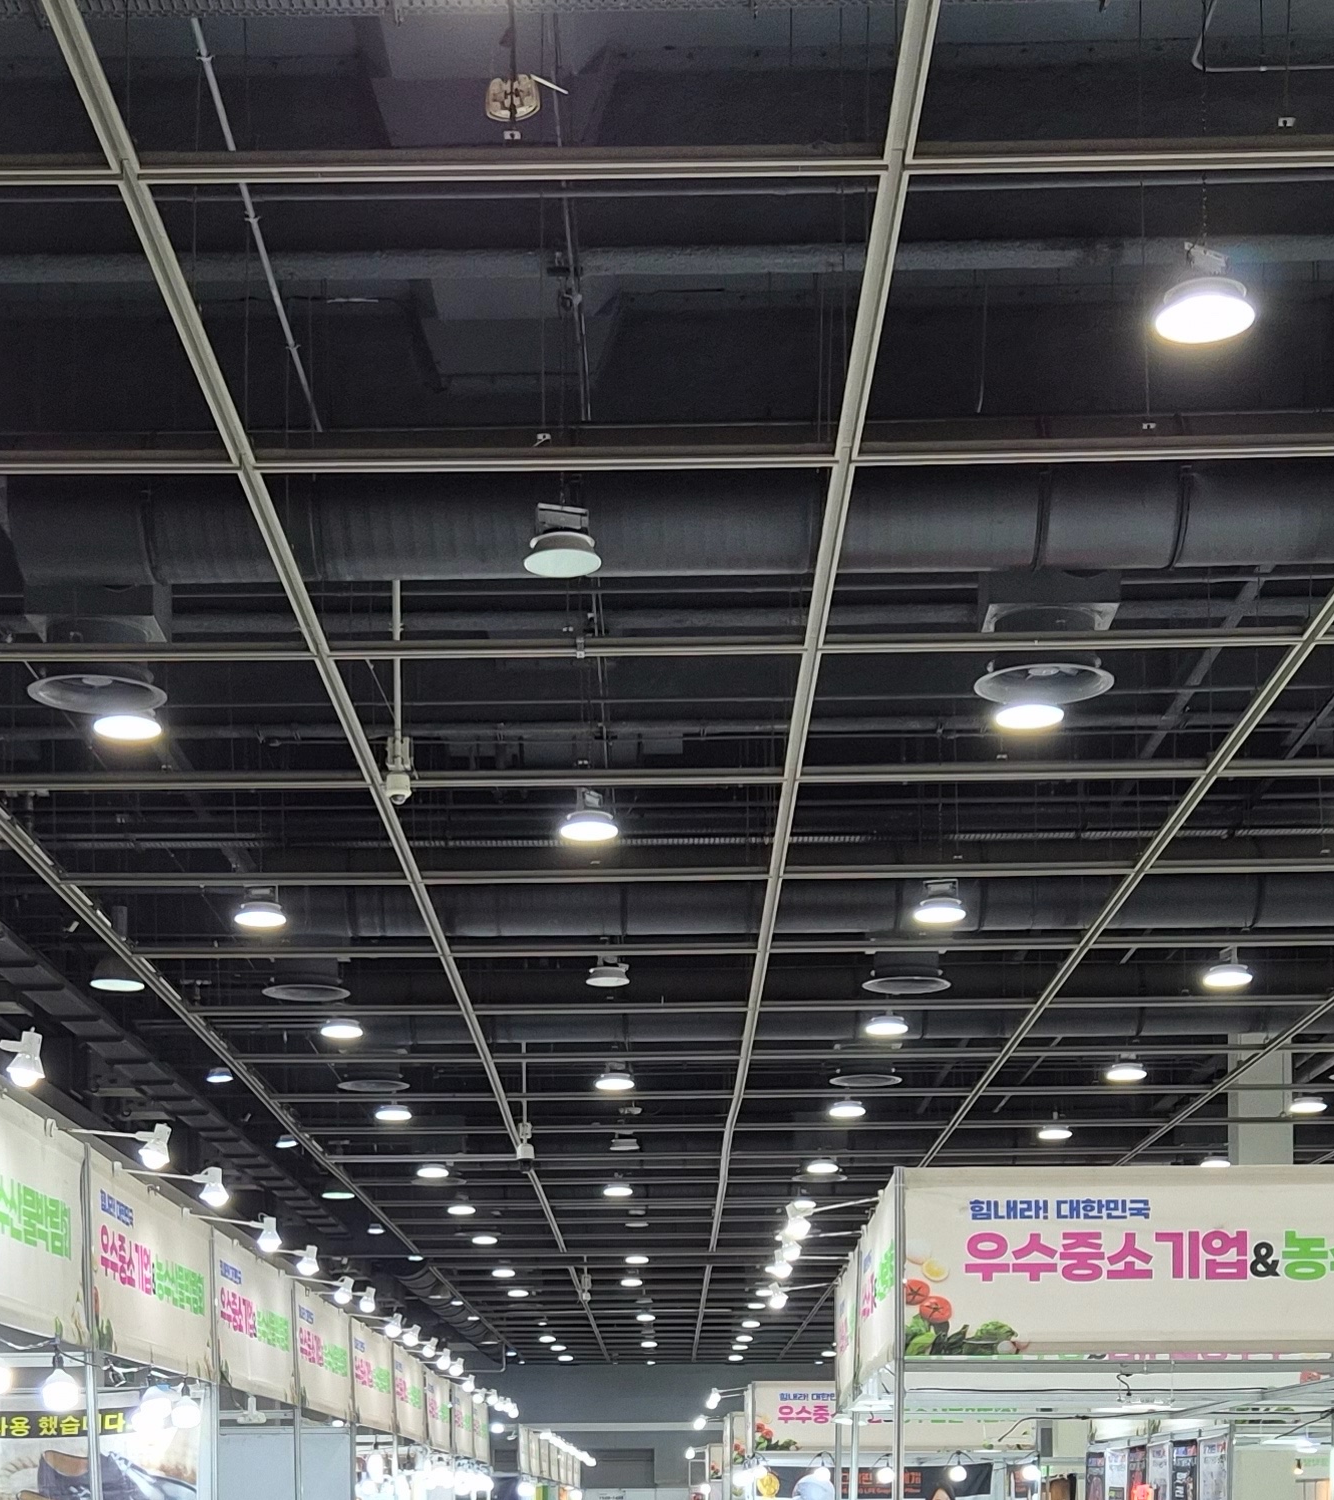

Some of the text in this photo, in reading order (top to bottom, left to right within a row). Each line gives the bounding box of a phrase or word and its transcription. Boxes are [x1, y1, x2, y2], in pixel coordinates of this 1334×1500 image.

[970, 1198, 1151, 1220] 힘내라! 대한민국
[778, 1405, 837, 1424] 우수중
